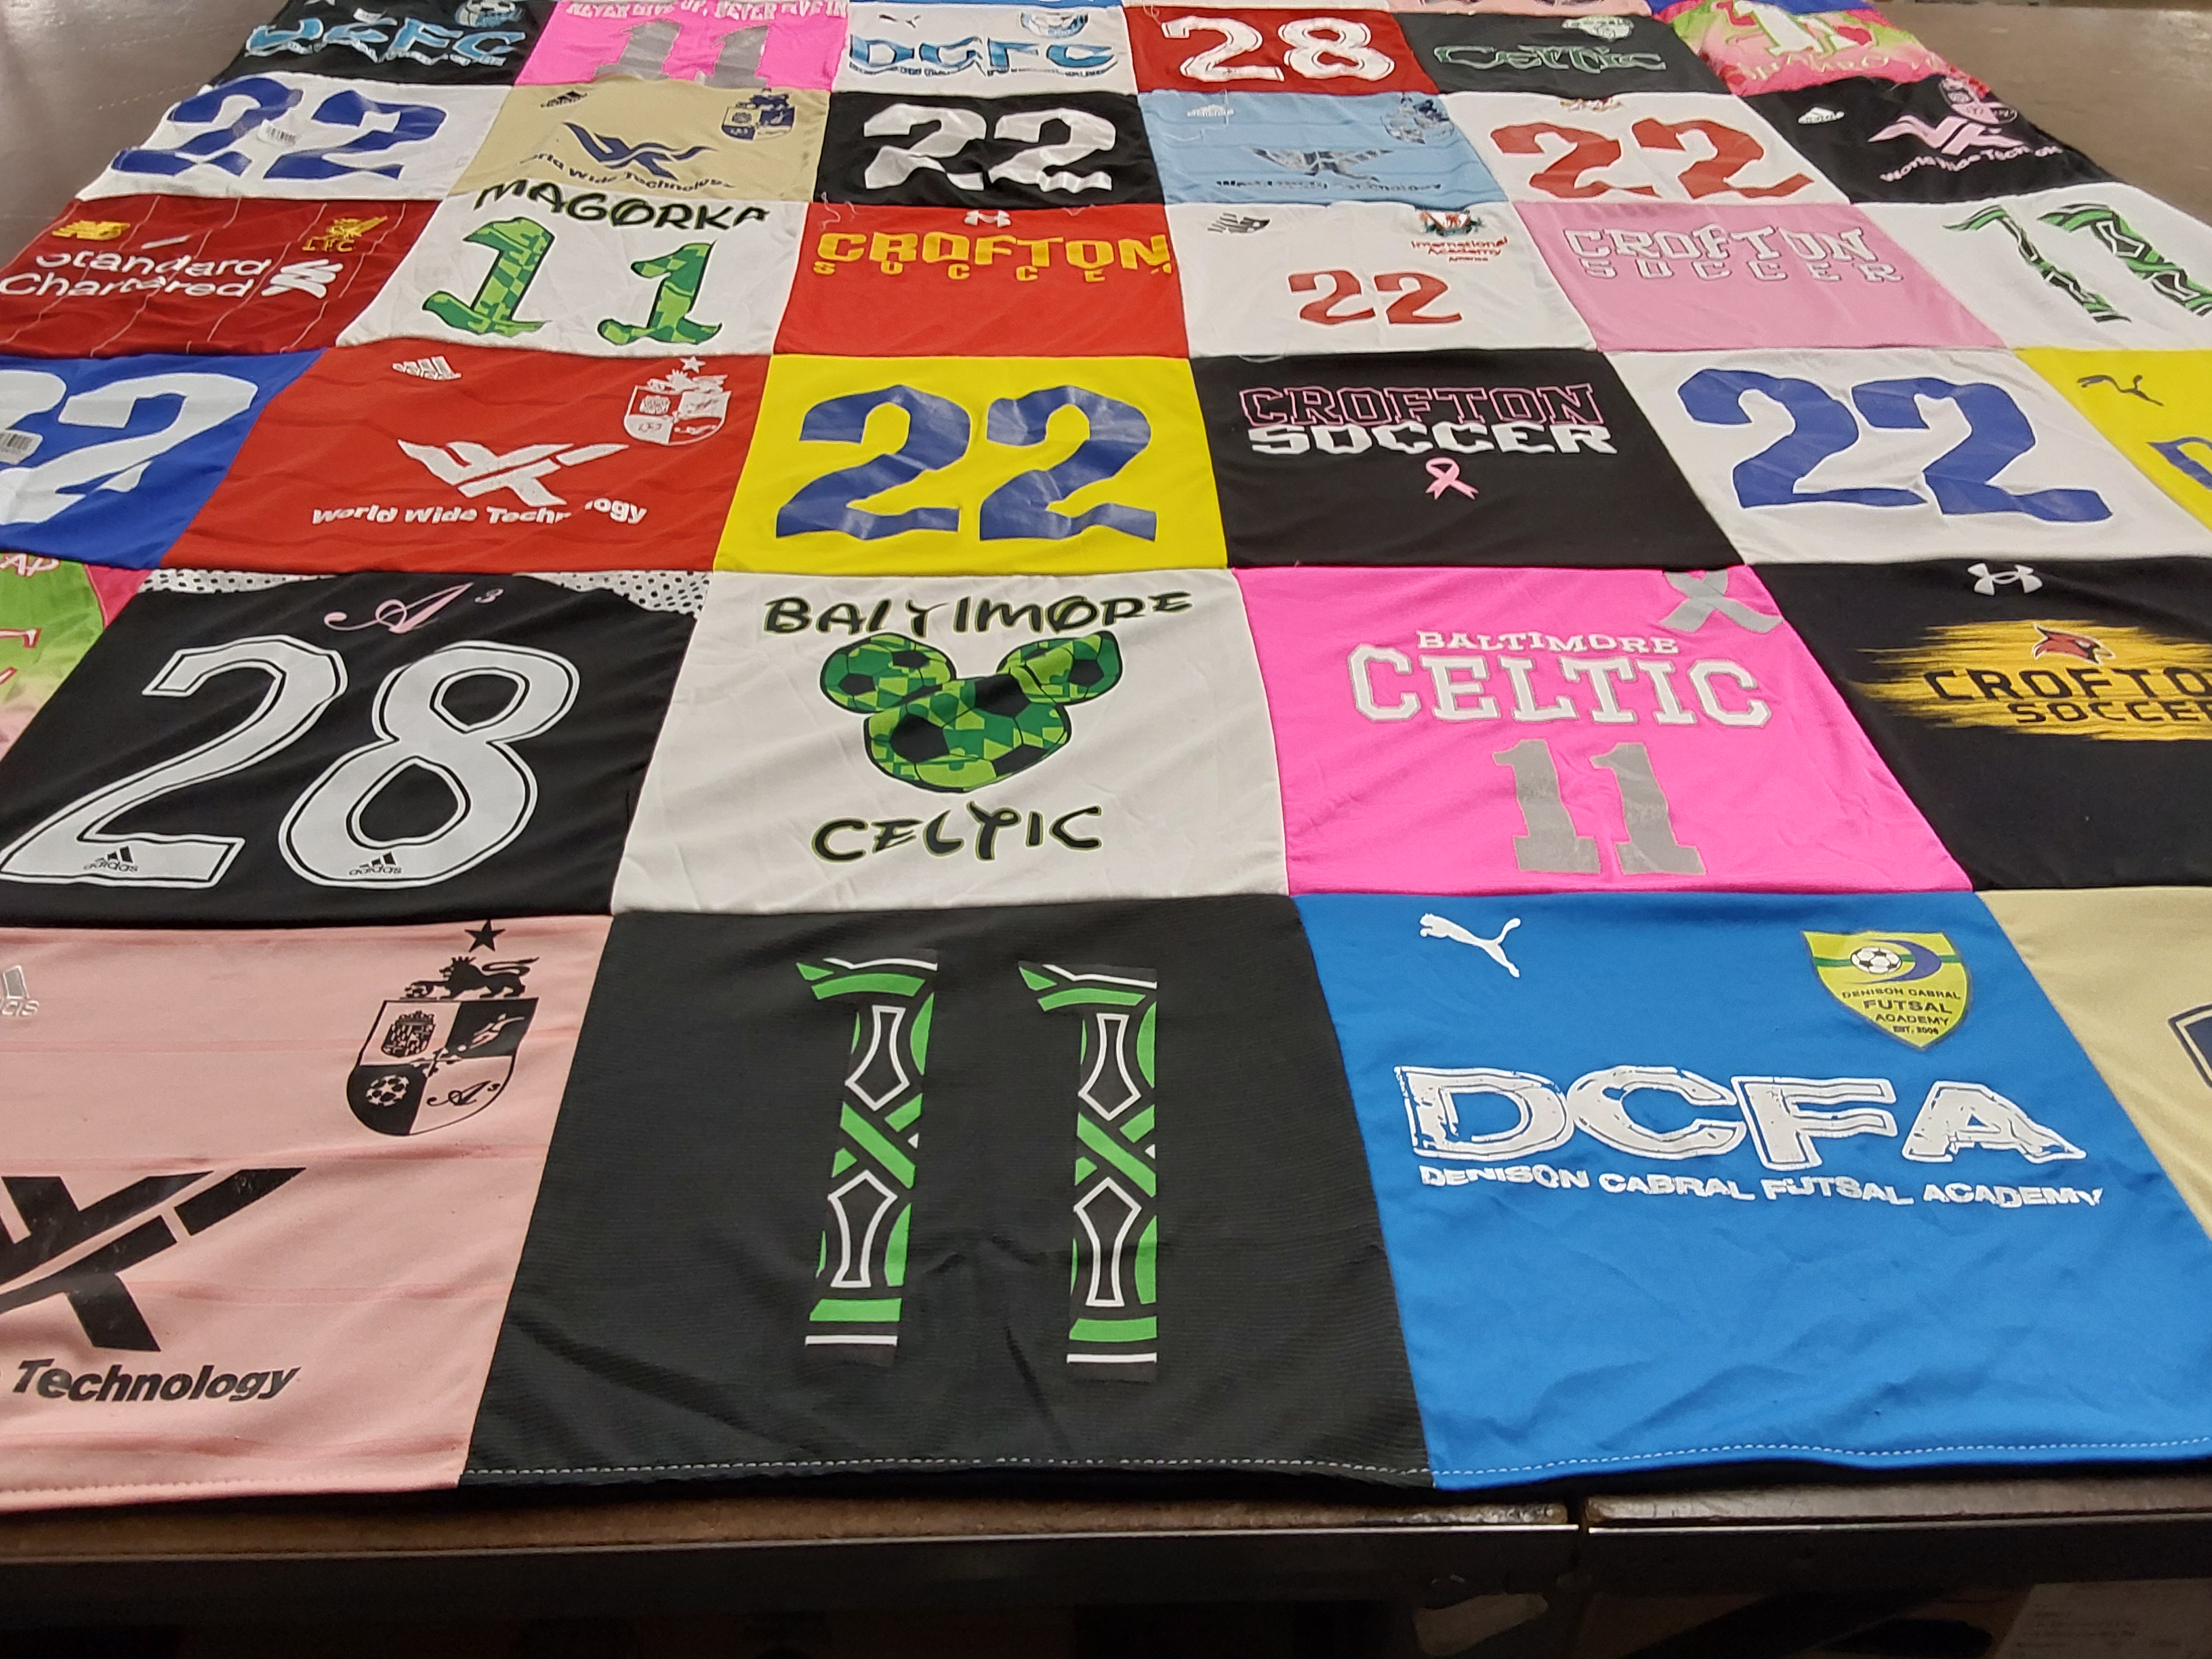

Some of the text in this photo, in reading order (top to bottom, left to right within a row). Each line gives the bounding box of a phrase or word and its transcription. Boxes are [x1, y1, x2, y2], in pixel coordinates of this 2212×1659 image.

[1161, 16, 1395, 81] 28
[112, 77, 447, 180] 22
[864, 103, 1116, 194] 22
[1490, 118, 1815, 200] 22
[817, 231, 1171, 270] CROFTON
[1563, 224, 1879, 262] CROFTON
[422, 217, 724, 346] 11
[813, 260, 1172, 283] SOCCE
[1578, 258, 1904, 282] SOCCER
[1288, 270, 1462, 325] 22
[1240, 384, 1604, 426] CROFTON
[1248, 420, 1618, 455] SOCCER
[1677, 367, 2112, 524] 22
[775, 384, 1158, 542] 22
[312, 505, 398, 525] World
[405, 506, 478, 525] Wide
[1416, 630, 1680, 655] BALTIMORE
[1347, 644, 1773, 727] CELTIC
[0, 634, 580, 888] 28
[811, 799, 1103, 863] CELTIC
[1492, 739, 1707, 876] 11
[83, 858, 139, 874] adidas
[349, 864, 402, 876] adidas
[1863, 1000, 1953, 1015] FUTSAL
[1875, 1013, 1950, 1026] ACADEMY
[1392, 1065, 2087, 1172] DCFA
[796, 951, 1158, 1372] 11
[1420, 1164, 2105, 1209] DENISON CABRAL FUTSAL ACADEMY
[13, 1358, 302, 1401] Technology
